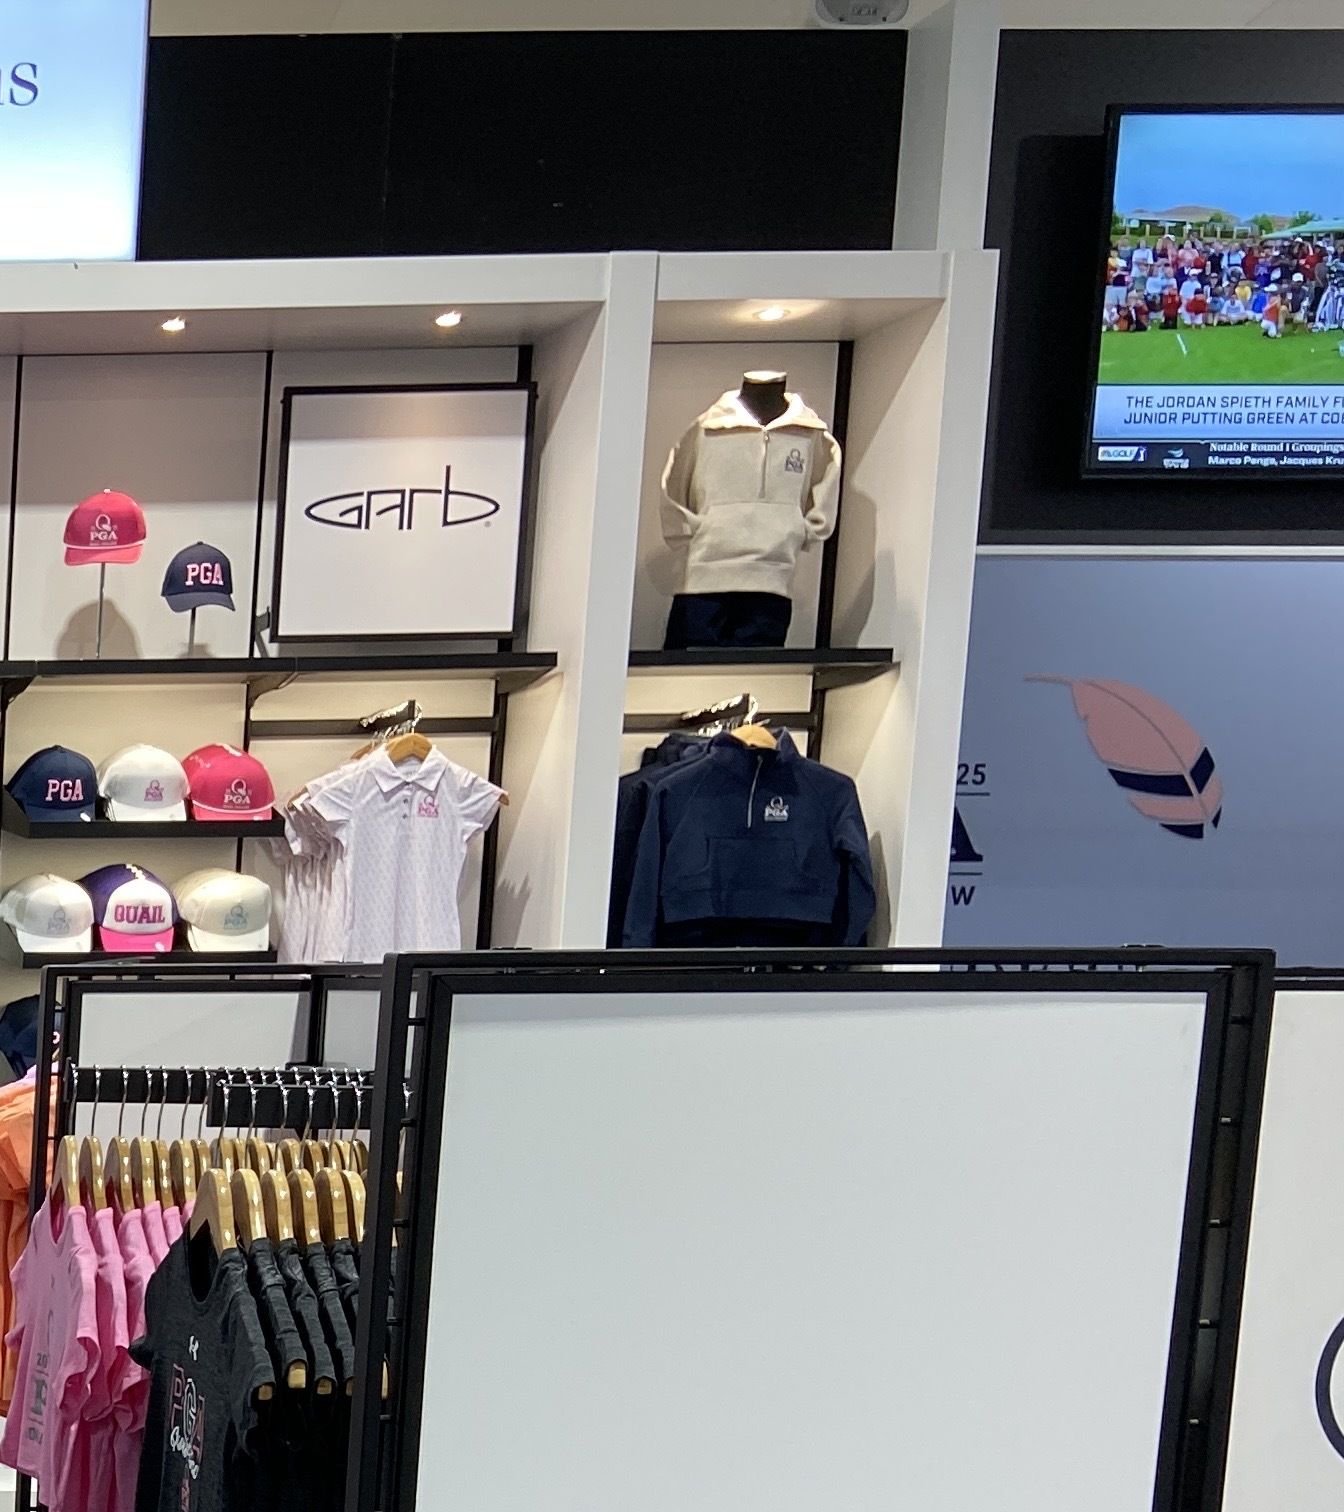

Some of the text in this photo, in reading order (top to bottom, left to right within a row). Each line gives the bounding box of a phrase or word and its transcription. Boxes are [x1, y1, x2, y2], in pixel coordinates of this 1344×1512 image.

[1127, 396, 1154, 408] THE
[1157, 396, 1217, 408] JORDAN
[1220, 396, 1272, 408] SPIETH
[1275, 396, 1330, 408] FAMILY
[1124, 412, 1177, 424] JUNIOR
[1181, 412, 1242, 424] PUTTING
[1246, 412, 1295, 424] GREEN
[1299, 412, 1318, 424] AT
[1209, 442, 1249, 452] Notable
[1250, 442, 1284, 452] Round
[1207, 455, 1242, 465] Marco
[1280, 455, 1323, 467] Jacques
[90, 531, 118, 541] PGA
[185, 562, 224, 586] PGA
[45, 778, 84, 801] PGA
[224, 794, 250, 804] PGA
[114, 904, 165, 924] QUAIL
